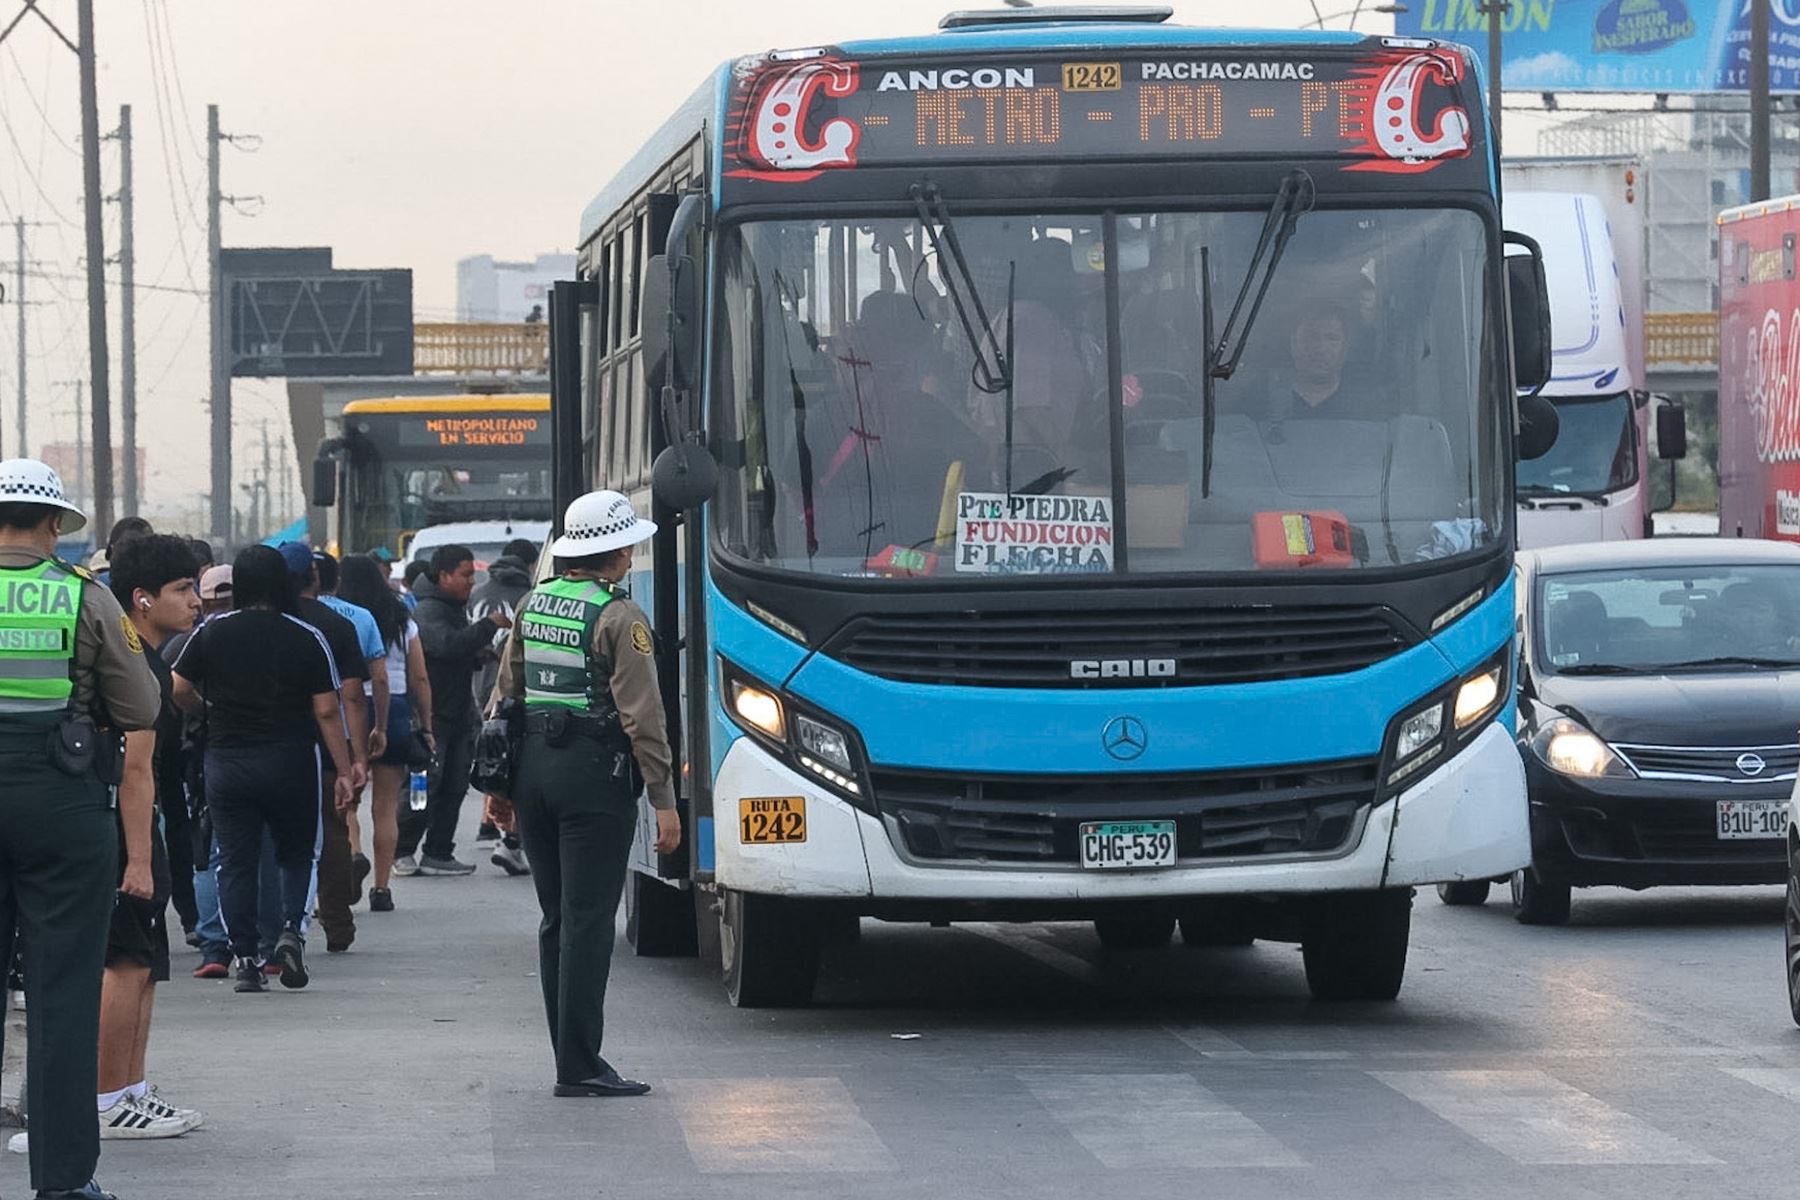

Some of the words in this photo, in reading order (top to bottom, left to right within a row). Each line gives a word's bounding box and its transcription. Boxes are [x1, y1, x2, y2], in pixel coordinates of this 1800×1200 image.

[877, 68, 1034, 91] ANCON
[1066, 66, 1117, 88] 1242
[1141, 62, 1314, 80] PACHACAMAC
[916, 87, 1060, 146] METRO
[1139, 83, 1222, 141] PRO
[426, 418, 538, 432] METROPOLITANO
[440, 432, 459, 445] EN
[464, 431, 525, 445] SERVICIO
[1007, 496, 1109, 522] PIEDRA
[965, 520, 1111, 545] FUNDICION
[961, 544, 1109, 568] FLECHA
[0, 581, 74, 614] ICIA
[526, 594, 586, 620] POLICIA
[521, 620, 581, 647] TRANSITO
[1071, 659, 1176, 678] CAIO
[751, 799, 791, 812] RUTA
[742, 812, 803, 841] 1242
[1111, 825, 1145, 833] PERU
[1721, 811, 1788, 833] B1U-109
[1085, 833, 1171, 862] CHG-539
